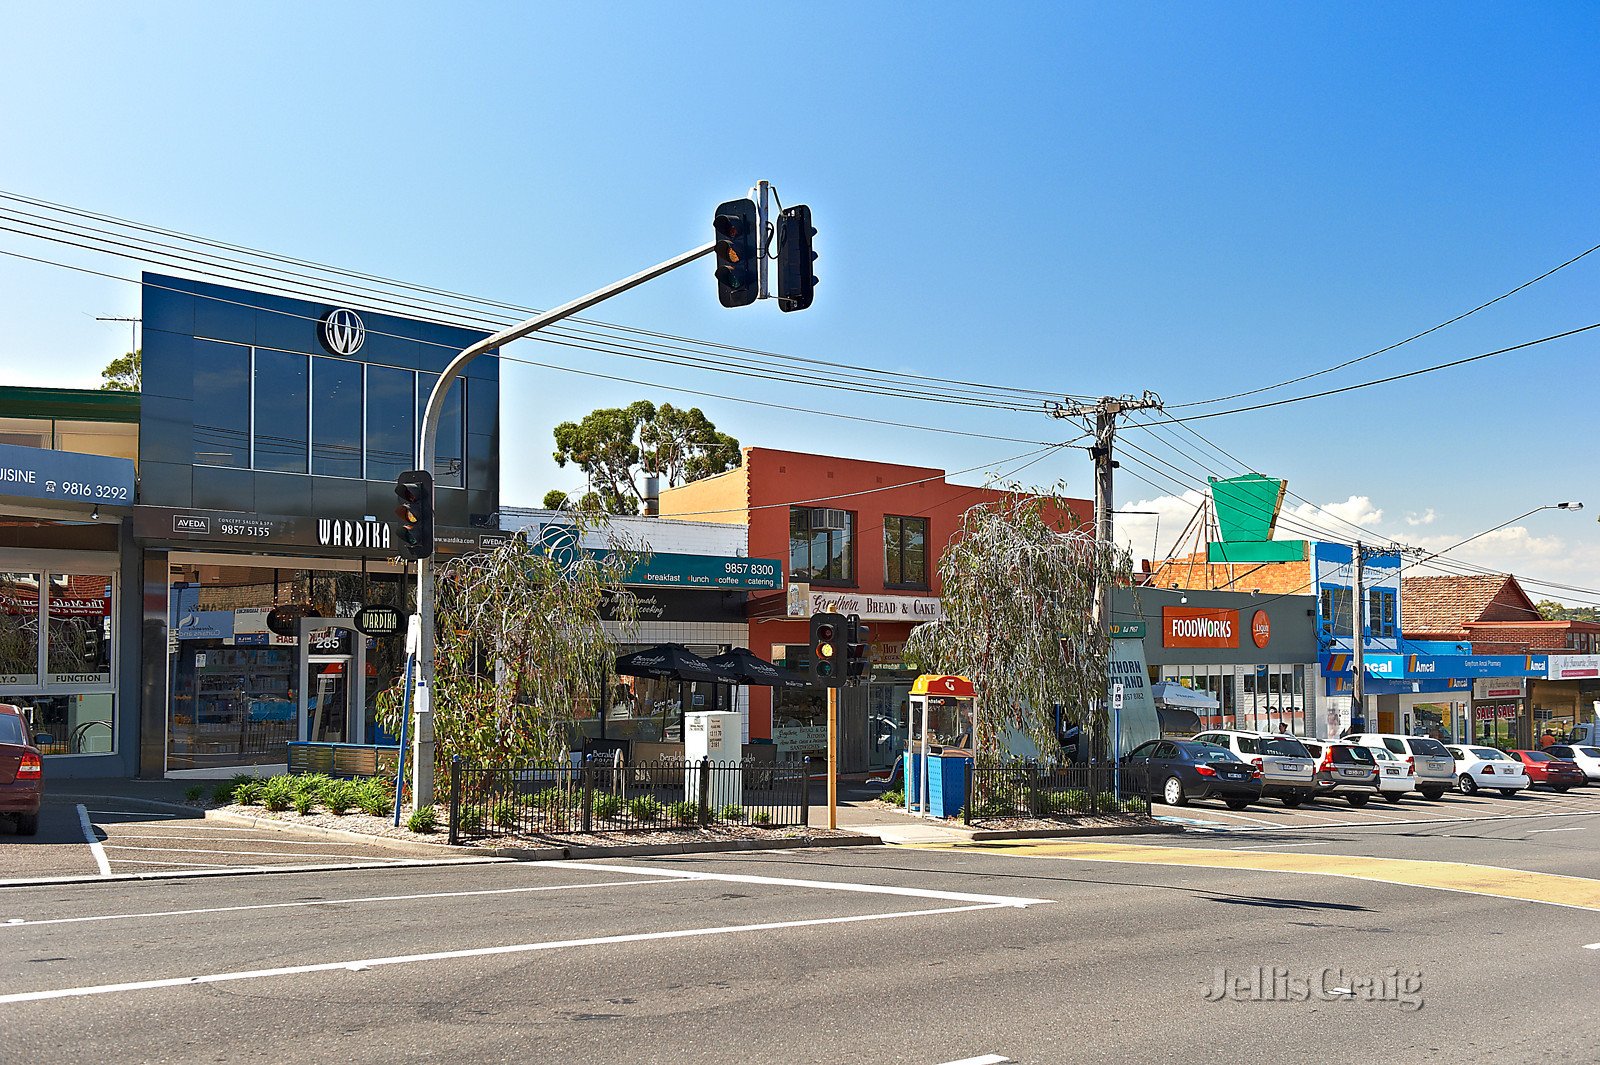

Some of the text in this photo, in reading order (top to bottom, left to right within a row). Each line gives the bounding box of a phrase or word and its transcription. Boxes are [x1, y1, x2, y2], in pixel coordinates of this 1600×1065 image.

[62, 481, 127, 500] 9816 3292
[177, 519, 206, 528] AVEDA
[221, 524, 270, 537] 9857 5155
[319, 518, 390, 549] WARDIKA
[482, 538, 503, 546] AVEDA
[725, 562, 774, 576] 9857 8300
[647, 573, 774, 588] breakfast lunch coffee catering
[866, 597, 896, 614] BREAD
[901, 602, 908, 614] &
[913, 599, 936, 615] CAKE
[362, 613, 397, 629] WARDIKA
[316, 636, 340, 649] 285
[1415, 660, 1435, 673] Amcal
[1530, 660, 1546, 671] Amcal
[56, 674, 101, 683] FUNCTION
[1476, 703, 1516, 720] SALE SALE
[592, 749, 616, 758] Berald
